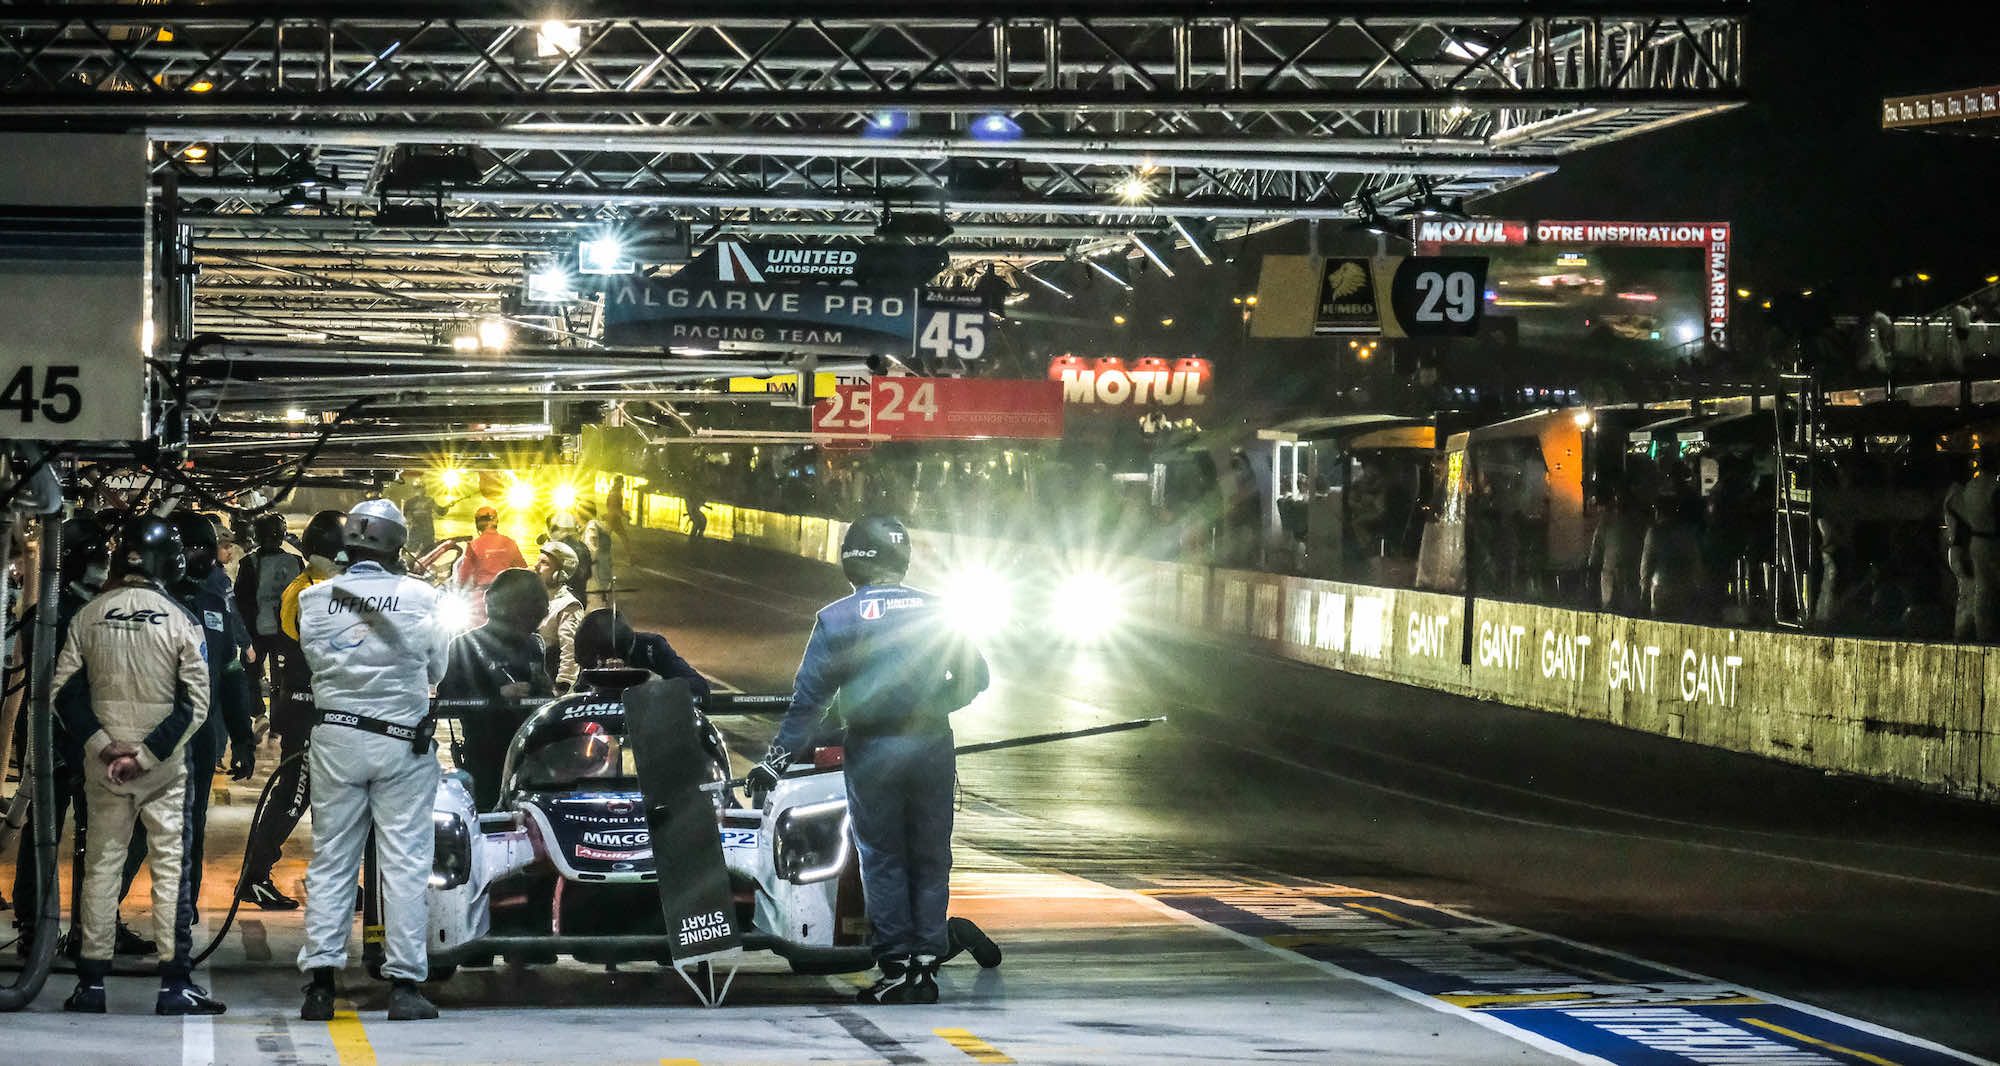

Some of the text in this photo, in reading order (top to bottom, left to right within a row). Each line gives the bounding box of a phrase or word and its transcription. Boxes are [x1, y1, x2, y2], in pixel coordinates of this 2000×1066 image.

[1418, 222, 1507, 242] MOTUL
[1587, 226, 1705, 242] INSPIRATION
[767, 249, 857, 264] UNITED
[765, 264, 854, 275] AUTOSPORTS
[1710, 227, 1727, 318] DEMARRE
[616, 286, 904, 317] ALGARVE PRO
[1415, 271, 1476, 323] 29
[1322, 304, 1374, 315] JUMBO
[673, 324, 843, 344] RACING TEAM
[919, 311, 985, 360] 45
[0, 365, 82, 424] 45
[1061, 369, 1205, 404] MOTUL
[818, 391, 872, 428] 25
[876, 381, 938, 421] 24
[888, 532, 904, 544] TF
[327, 596, 401, 615] OFFICIAL
[104, 607, 169, 625] WEC
[1407, 611, 1449, 659] GANT
[1479, 620, 1525, 670] GANT
[1541, 629, 1591, 682] GANT
[1608, 639, 1660, 695] GANT
[1680, 648, 1743, 708] GANT
[324, 713, 359, 723] sparco
[387, 725, 416, 738] sparc
[564, 814, 629, 824] RICHARD
[583, 831, 650, 845] MMCG
[681, 911, 725, 932] START
[679, 923, 731, 946] ENGINE
